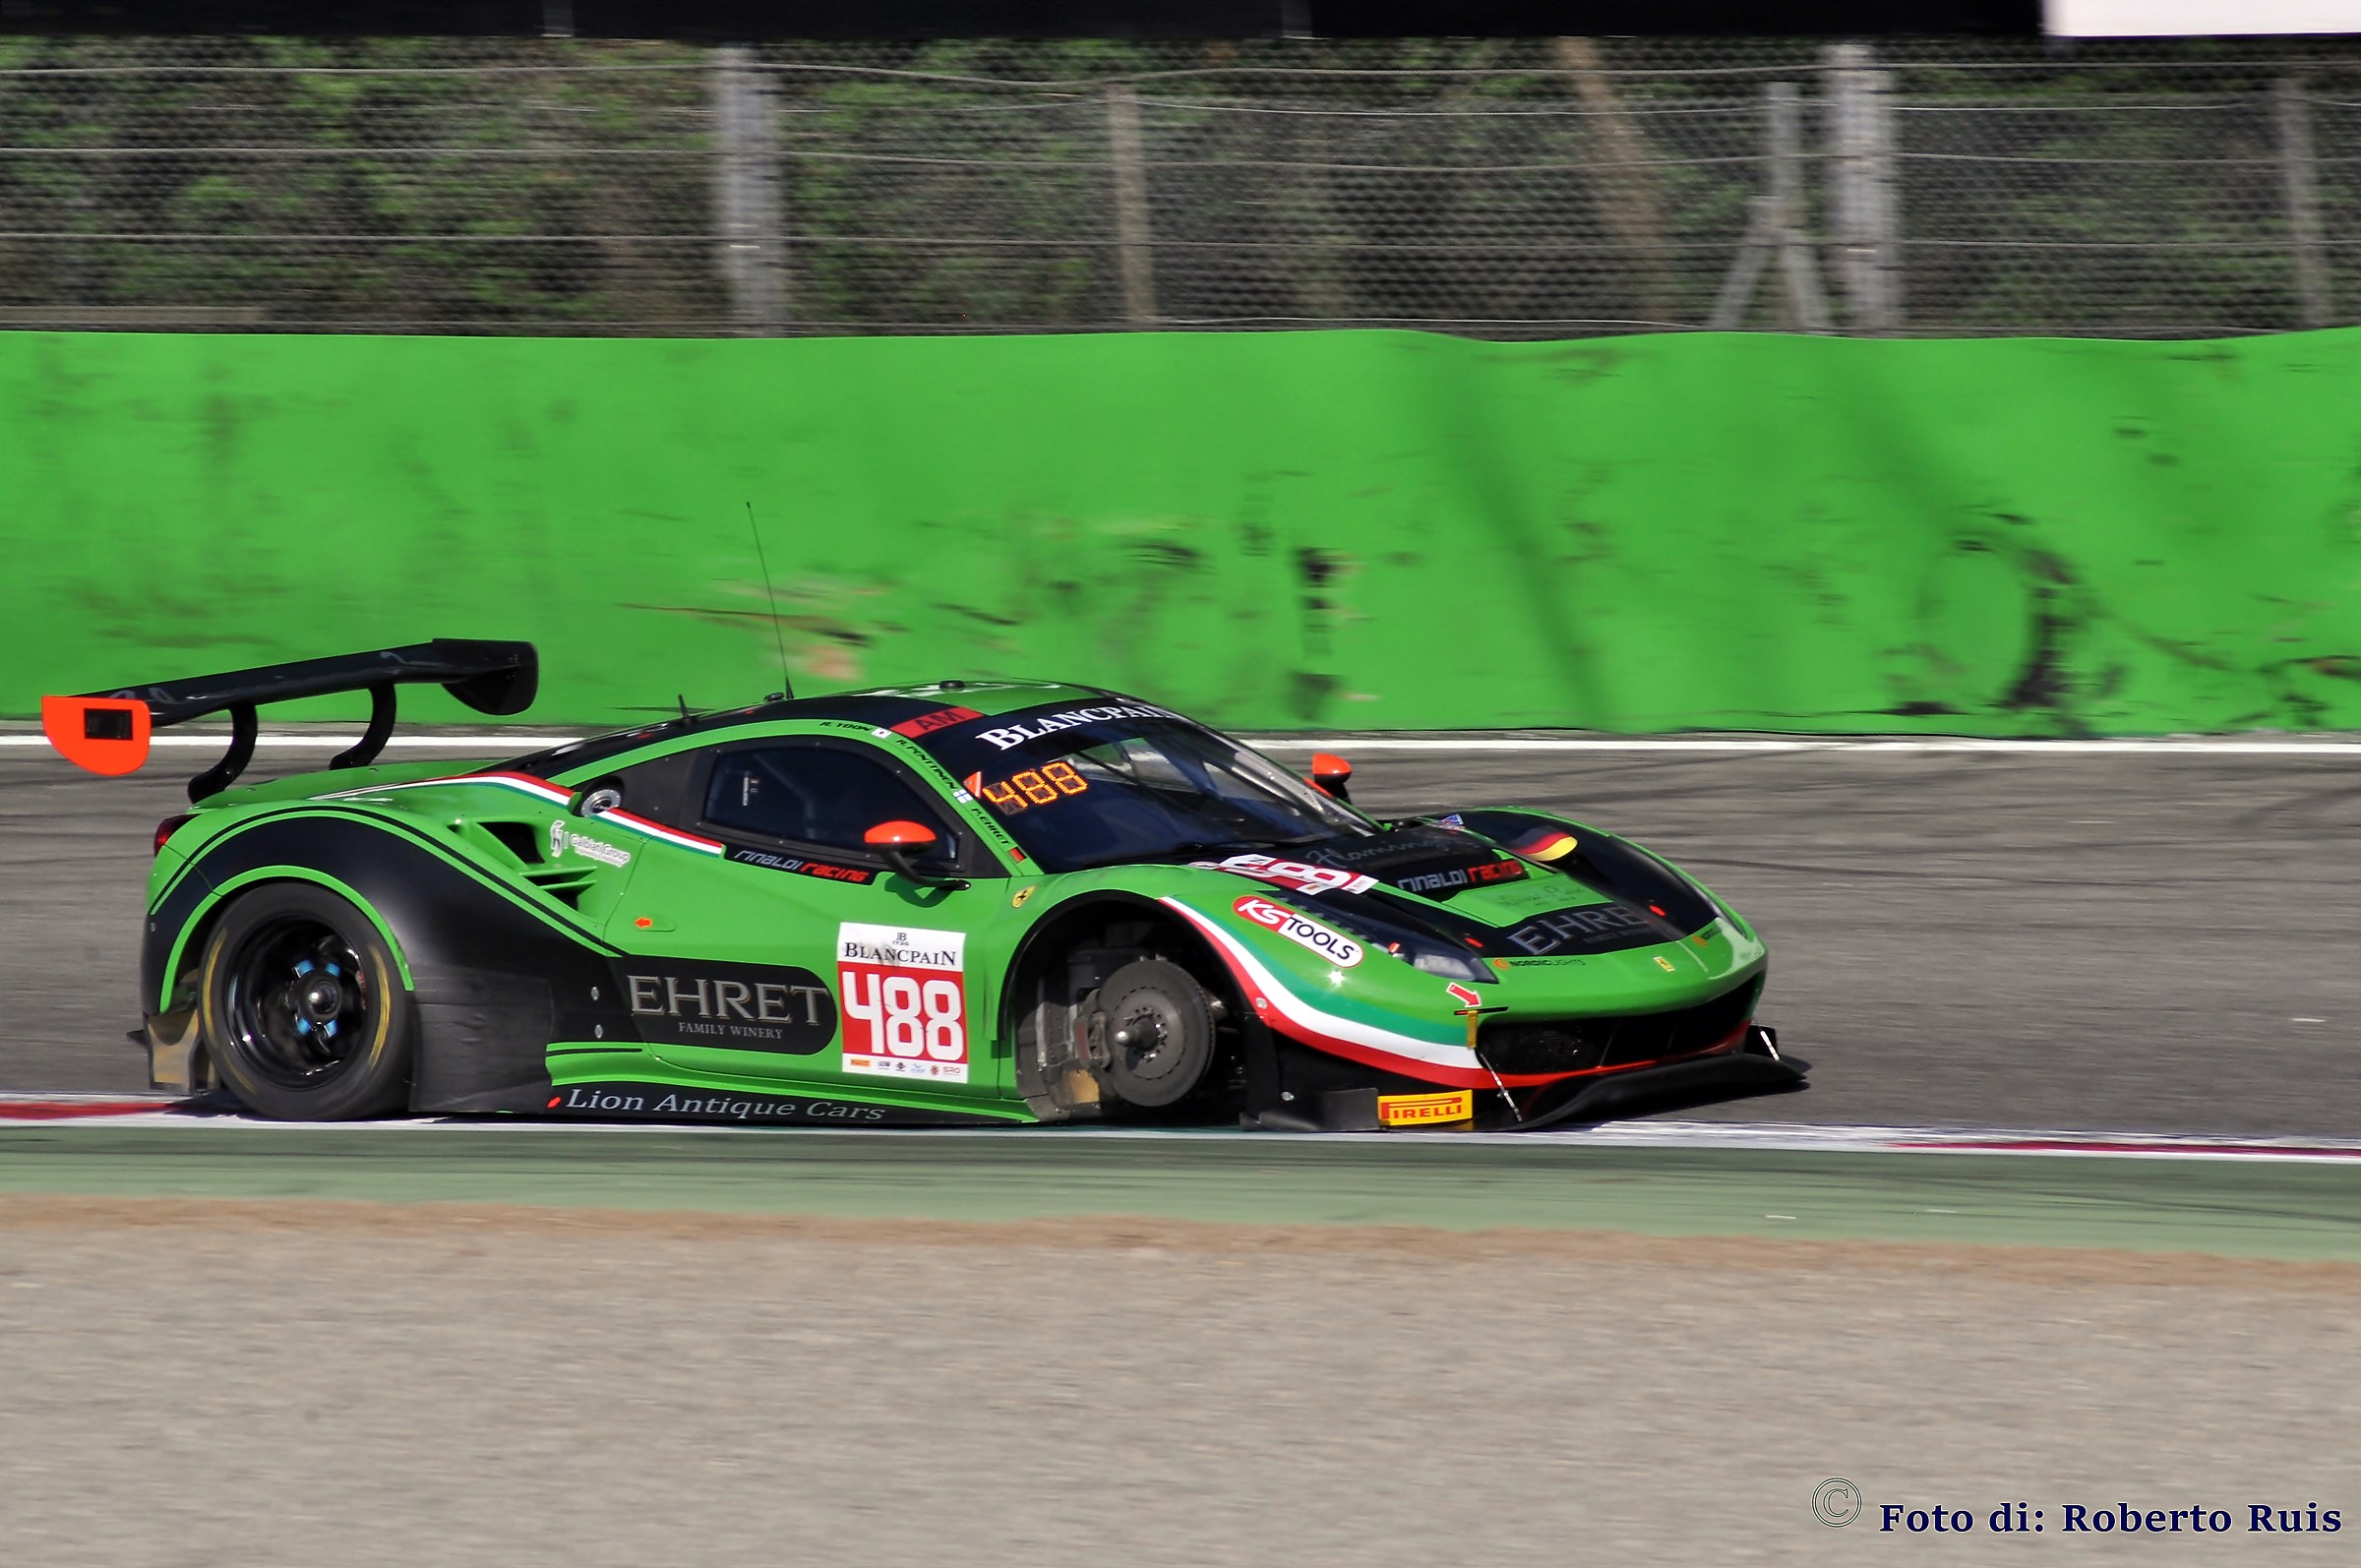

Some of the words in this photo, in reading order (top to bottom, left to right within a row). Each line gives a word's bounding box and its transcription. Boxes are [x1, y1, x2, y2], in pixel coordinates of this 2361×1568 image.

[915, 711, 962, 731] AM
[982, 760, 1088, 810] 488
[1286, 916, 1356, 961] TOOLS
[1506, 906, 1649, 956] EHRE
[844, 941, 957, 967] BLANCPAIN
[627, 974, 830, 1026] EHRET
[841, 971, 964, 1061] 488
[679, 1022, 726, 1036] FAMILY
[730, 1026, 783, 1040] WINERY
[567, 1088, 643, 1111] Lion
[652, 1093, 797, 1119] Antique
[806, 1100, 886, 1120] Cars
[1380, 1097, 1462, 1119] PIRELLI
